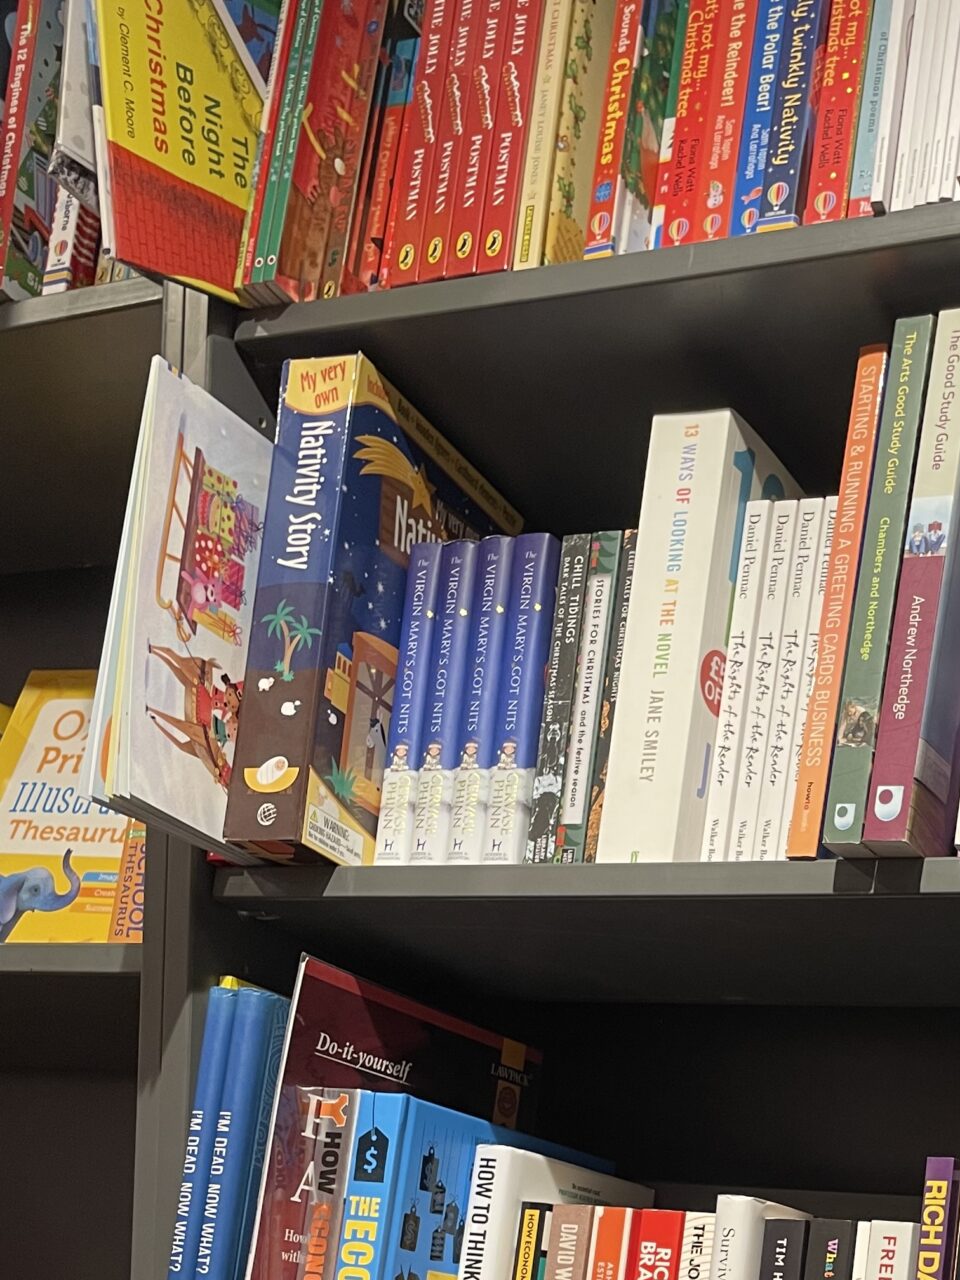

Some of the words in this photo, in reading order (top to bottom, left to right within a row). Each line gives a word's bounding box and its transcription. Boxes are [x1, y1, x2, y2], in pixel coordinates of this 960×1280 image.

[118, 7, 125, 21] by
[616, 4, 635, 53] Sounds
[732, 13, 747, 37] the
[769, 6, 782, 30] the
[120, 23, 131, 77] Clement
[721, 41, 743, 108] Reindeer!
[763, 33, 780, 71] Polar
[781, 19, 810, 88] twinkly
[145, 0, 168, 154] Christmas
[756, 74, 776, 112] Bear!
[125, 98, 135, 138] Moore
[176, 62, 196, 166] Before
[202, 95, 225, 178] Night
[601, 58, 630, 166] Christmas
[772, 94, 800, 166] Nativity
[232, 137, 249, 189] The
[493, 132, 512, 206] POSTMAN
[852, 366, 876, 438] STARTING
[286, 419, 333, 508] Nativity
[851, 444, 865, 454] &
[837, 459, 865, 533] RUNNING
[277, 510, 320, 570] Story
[836, 539, 853, 550] A
[519, 562, 535, 610] VIRGIN
[573, 555, 584, 590] CHILL
[826, 555, 851, 630] GREETING
[514, 614, 529, 661] MARY'S
[566, 594, 578, 644] TIDINGS
[903, 595, 926, 649] Andrew
[510, 665, 521, 695] GOT
[819, 634, 841, 678] CARDS
[892, 653, 917, 720] Northedge
[505, 701, 517, 731] NITS
[805, 684, 832, 767] BUSINESS
[114, 842, 138, 937] THESAURUS
[314, 1032, 414, 1082] Do-it-yourself
[478, 1157, 496, 1196] HOW
[349, 1195, 380, 1217] THE
[472, 1202, 489, 1227] TO
[560, 1224, 578, 1265] DAVID
[776, 1237, 787, 1264] TIM
[825, 1239, 838, 1278] What
